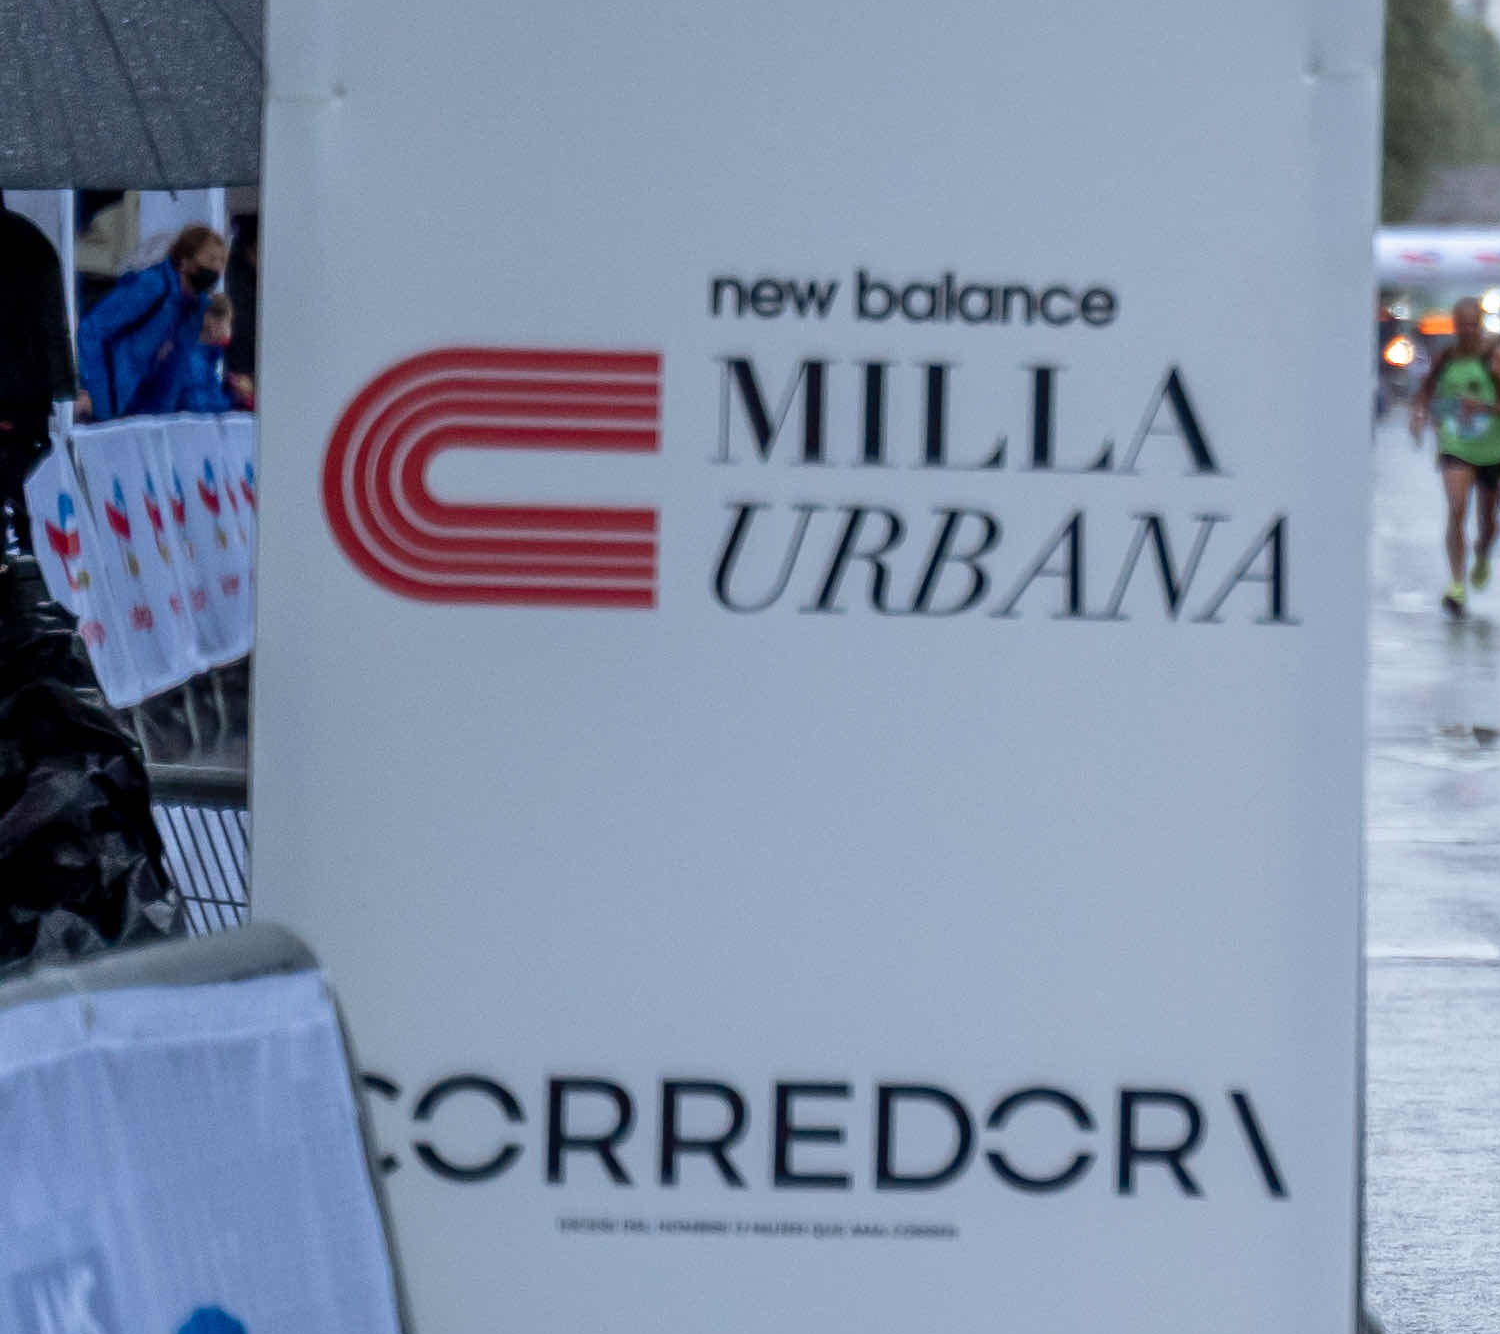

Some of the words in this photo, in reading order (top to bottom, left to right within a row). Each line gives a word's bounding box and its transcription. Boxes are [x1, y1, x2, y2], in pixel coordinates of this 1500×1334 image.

[708, 274, 839, 320] new
[854, 268, 1118, 327] balance
[711, 355, 1232, 476] MILLA
[710, 500, 1302, 626] URBANA
